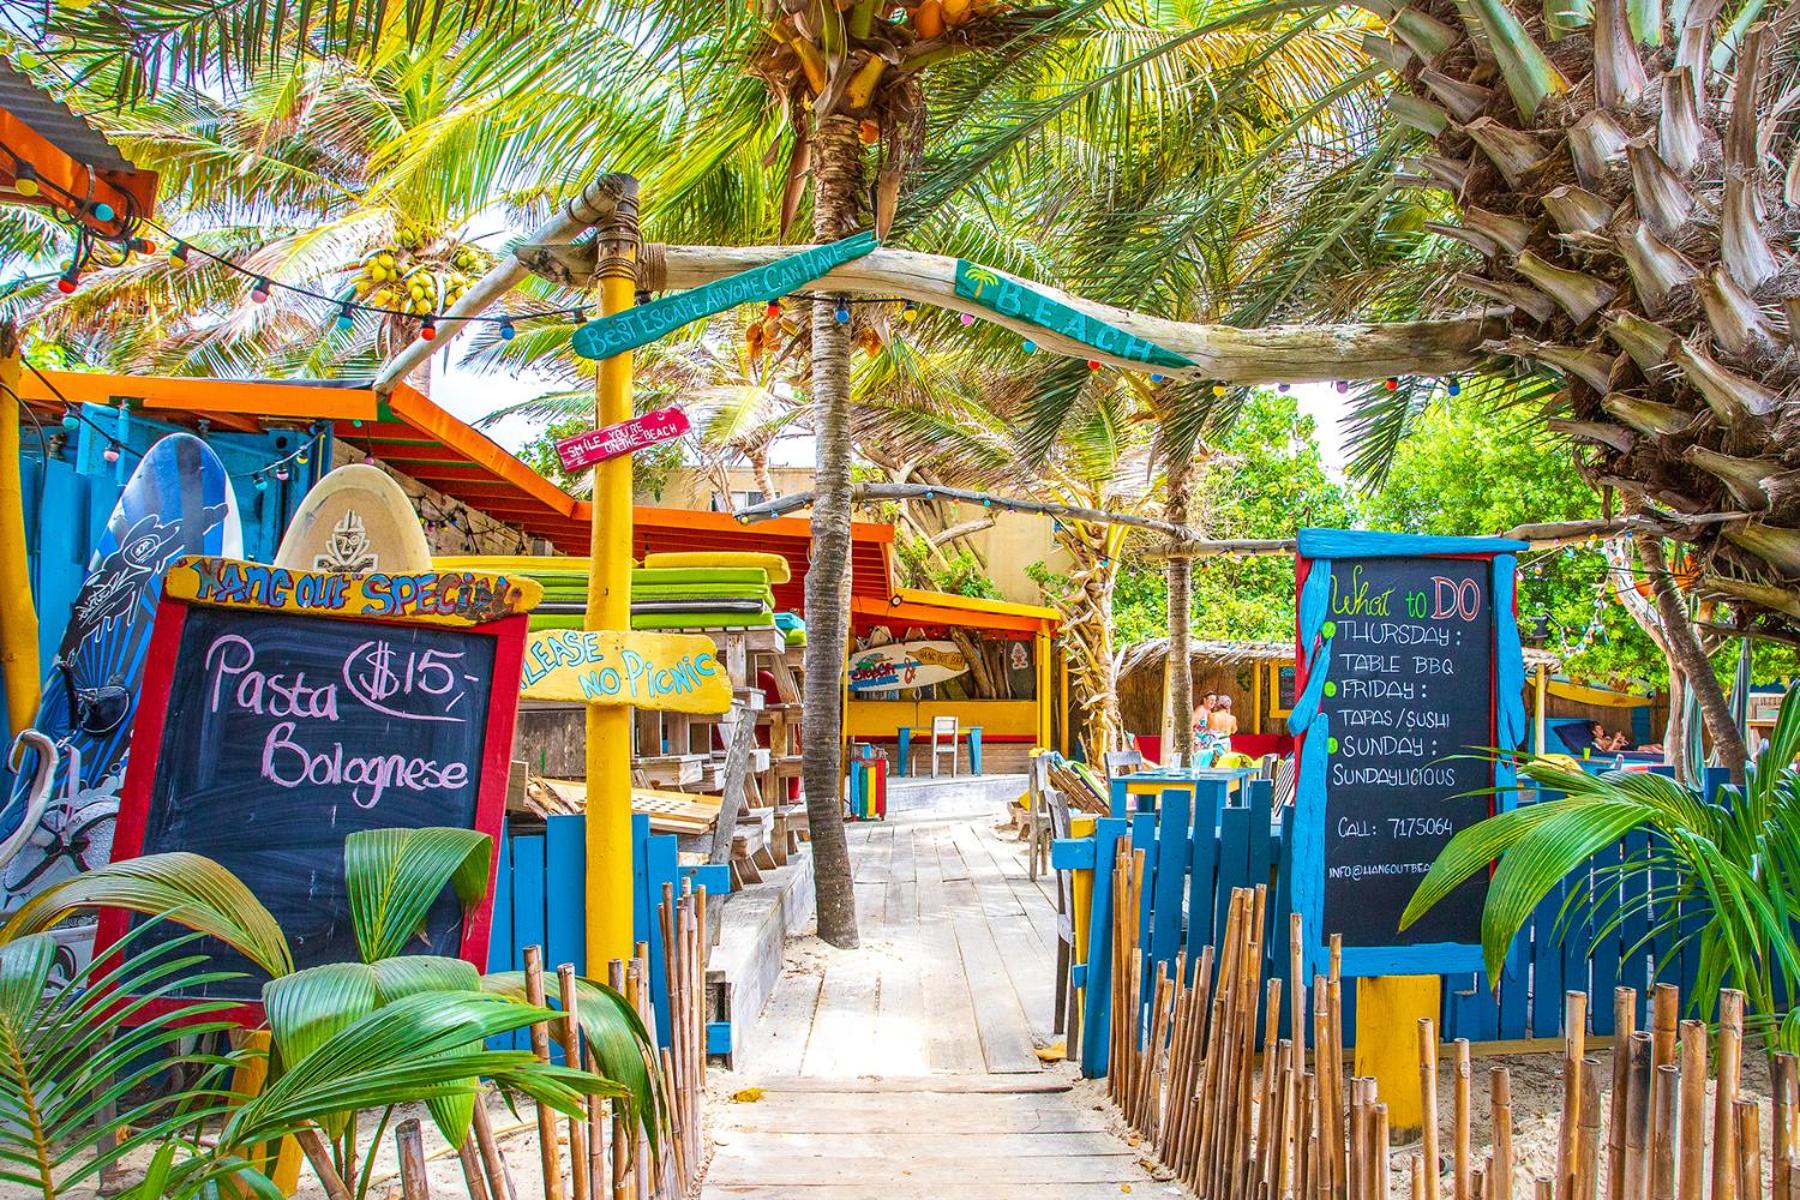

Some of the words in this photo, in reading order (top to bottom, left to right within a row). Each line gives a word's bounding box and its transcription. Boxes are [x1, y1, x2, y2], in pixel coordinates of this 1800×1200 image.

[640, 299, 703, 334] ESCAPE
[703, 276, 763, 313] ANYONE
[764, 265, 802, 291] CAN
[997, 281, 1154, 362] BEACH
[608, 422, 643, 440] YOU'RE
[643, 424, 677, 440] BEACH
[567, 436, 600, 458] SMILE
[1330, 564, 1396, 617] What
[1431, 576, 1480, 622] DO
[520, 631, 604, 690] LEASE
[1339, 654, 1400, 673] TABLE
[1412, 656, 1454, 675] BBQ
[205, 634, 339, 722] Pasta
[579, 667, 621, 699] NO
[260, 722, 468, 808] Bolognese
[1332, 763, 1456, 787] SUNDAYLICIOUS
[1387, 818, 1453, 839] 7175064
[1328, 862, 1435, 881] INFO@HANGOUTBEA
